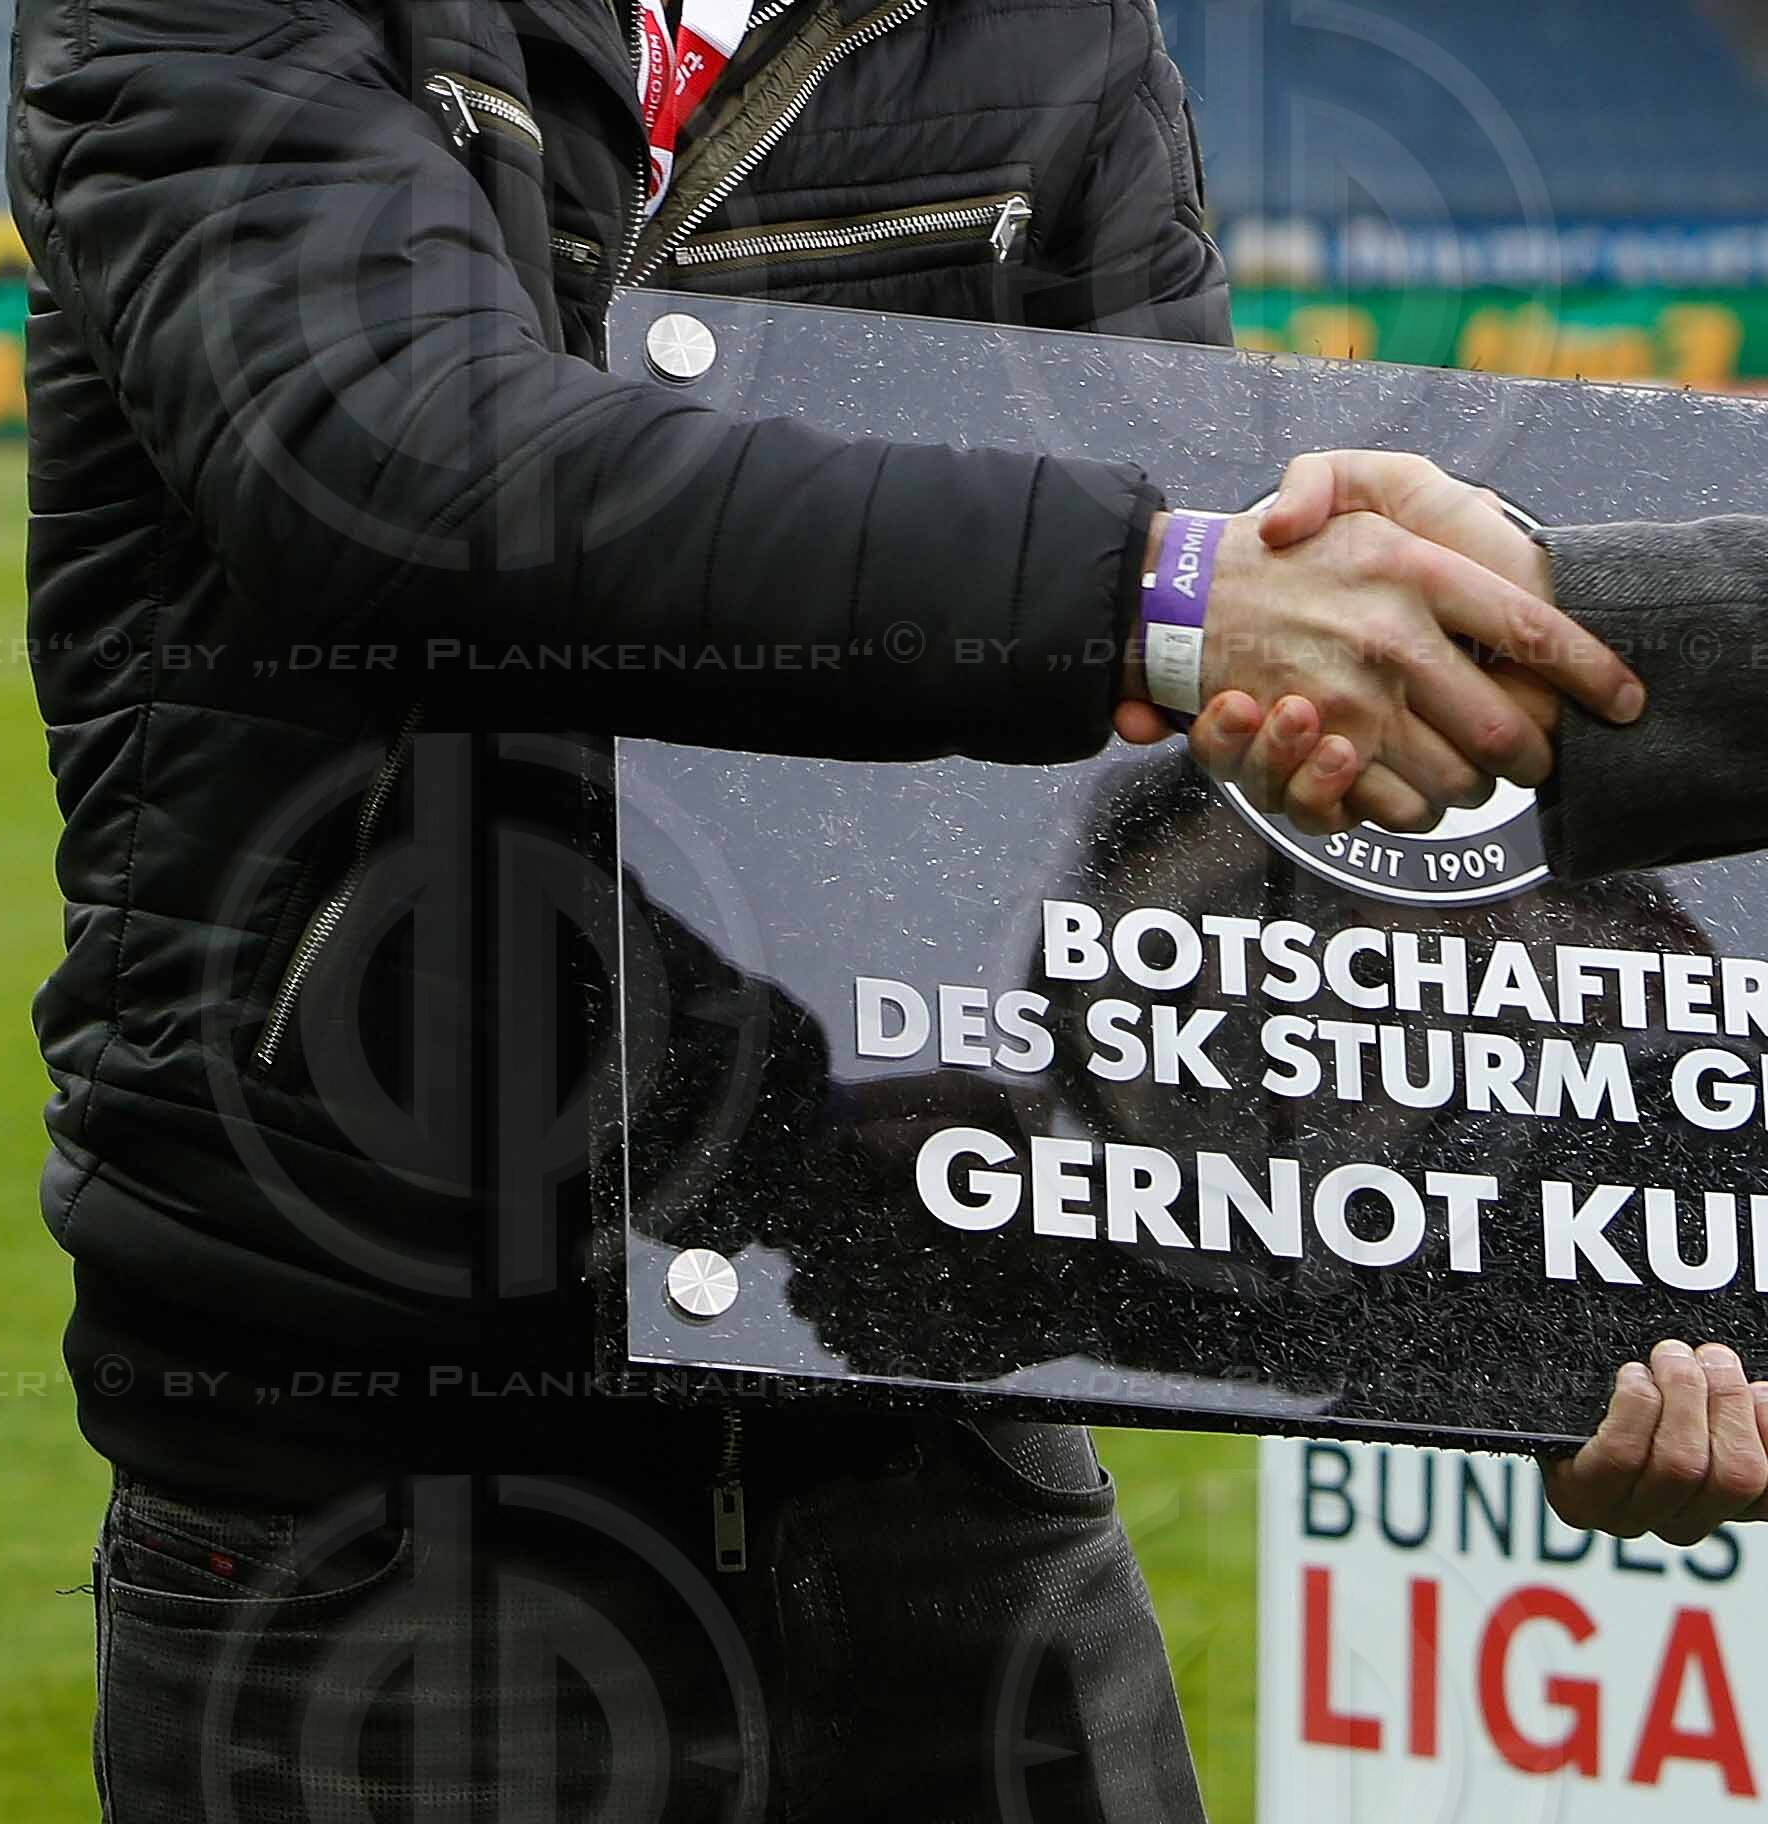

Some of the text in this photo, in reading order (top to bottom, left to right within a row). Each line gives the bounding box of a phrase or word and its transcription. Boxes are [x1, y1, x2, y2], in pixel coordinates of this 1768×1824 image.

[1325, 831, 1506, 882] SEIT 1909
[856, 976, 1055, 1073] DES
[1086, 998, 1232, 1090] SK
[1261, 1015, 1639, 1123] STURM
[916, 1126, 1498, 1273] GERNOT
[1301, 1565, 1758, 1800] LIGA
